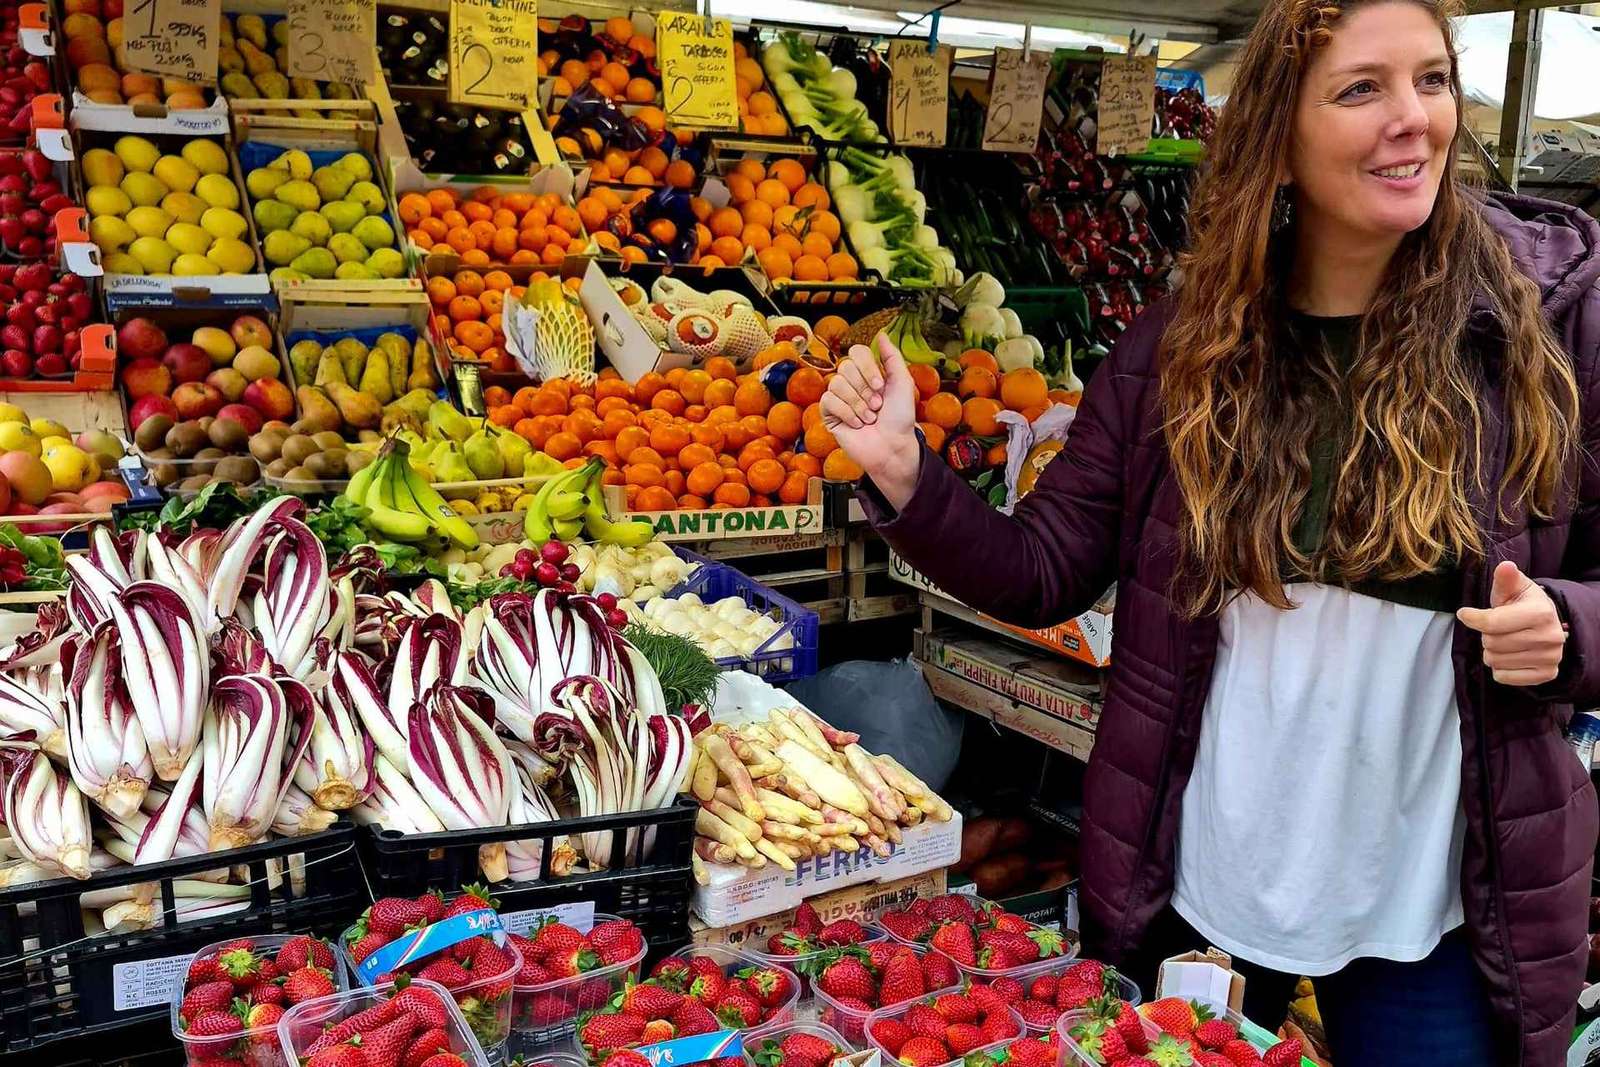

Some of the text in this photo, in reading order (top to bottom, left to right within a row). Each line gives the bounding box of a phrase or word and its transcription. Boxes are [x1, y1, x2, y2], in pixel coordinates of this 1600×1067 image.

[293, 32, 328, 73] 3
[461, 43, 506, 99] 2
[670, 75, 712, 120] 2
[896, 87, 911, 143] 1
[985, 102, 1013, 143] 2
[1045, 695, 1074, 719] ALTA
